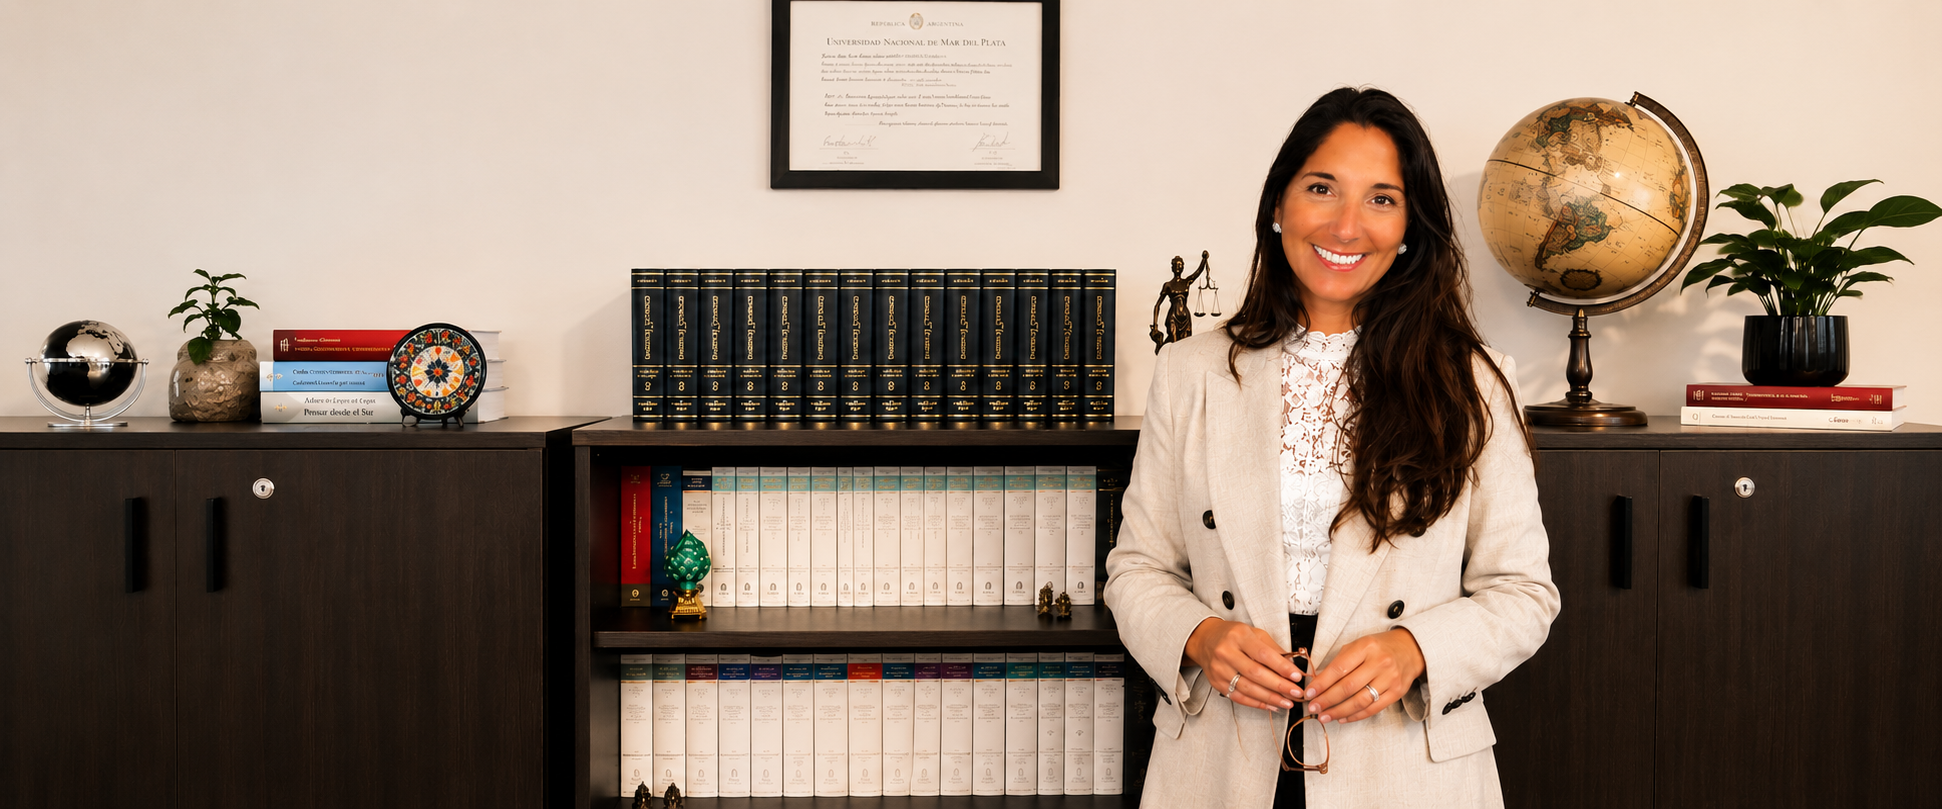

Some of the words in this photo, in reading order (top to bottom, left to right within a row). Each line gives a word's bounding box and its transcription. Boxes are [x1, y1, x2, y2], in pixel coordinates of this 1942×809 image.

[826, 37, 881, 46] UNIVERSIDAD
[884, 37, 925, 46] NACIONAL
[941, 38, 960, 46] MAR
[981, 38, 1006, 47] PLATA
